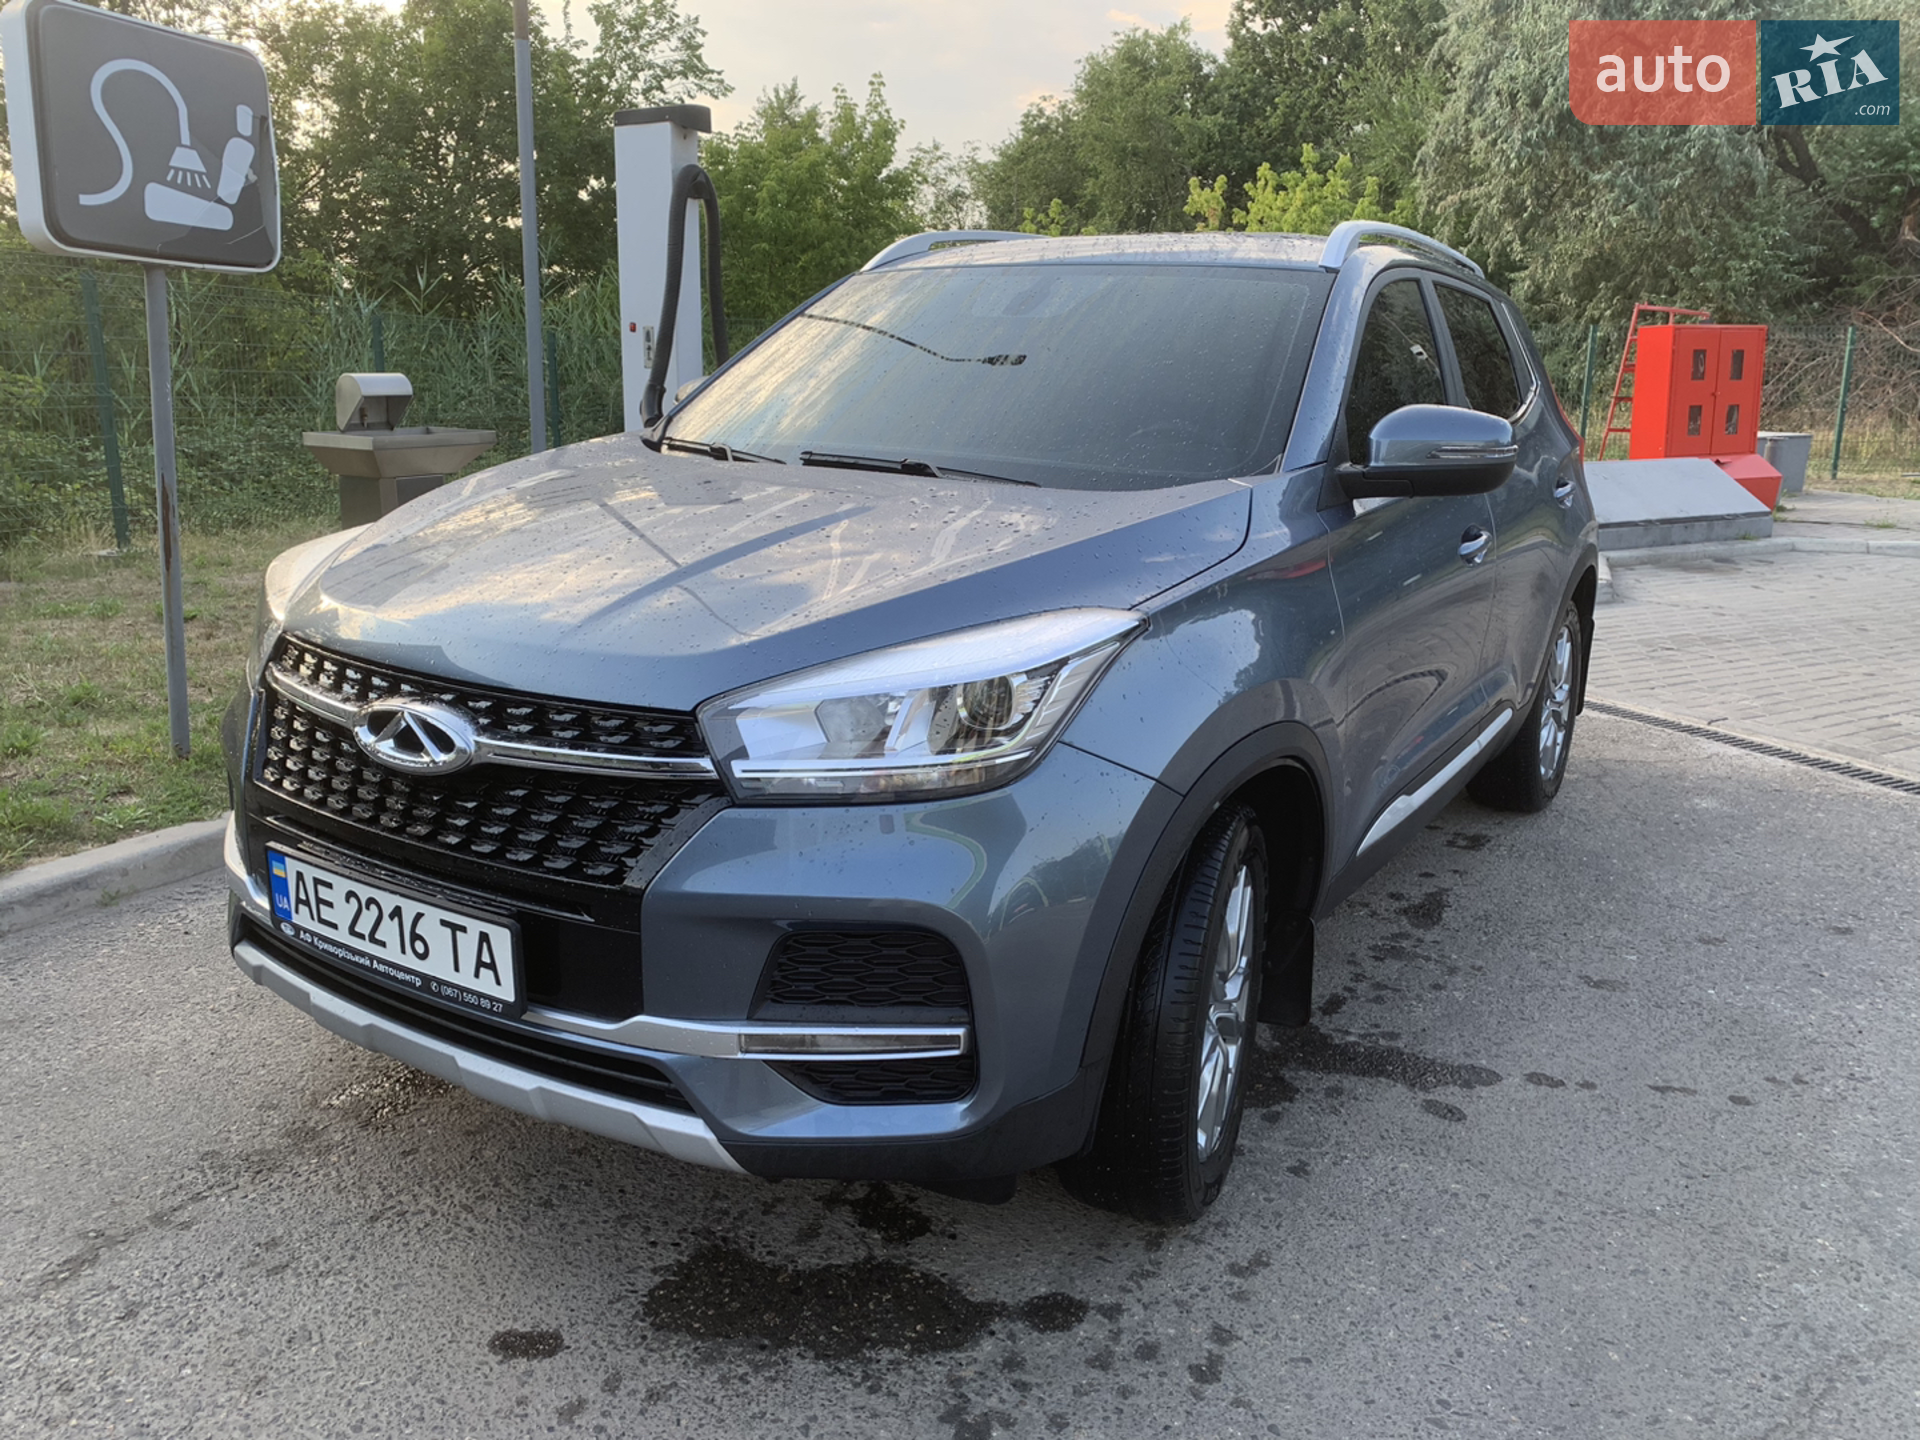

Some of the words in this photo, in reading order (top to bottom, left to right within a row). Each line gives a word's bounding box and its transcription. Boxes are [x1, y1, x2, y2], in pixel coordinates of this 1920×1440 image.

[275, 893, 290, 911] UA
[295, 870, 338, 930] AE
[344, 889, 430, 961] 2216
[439, 918, 502, 986] TA
[372, 959, 422, 987] Автоцентр
